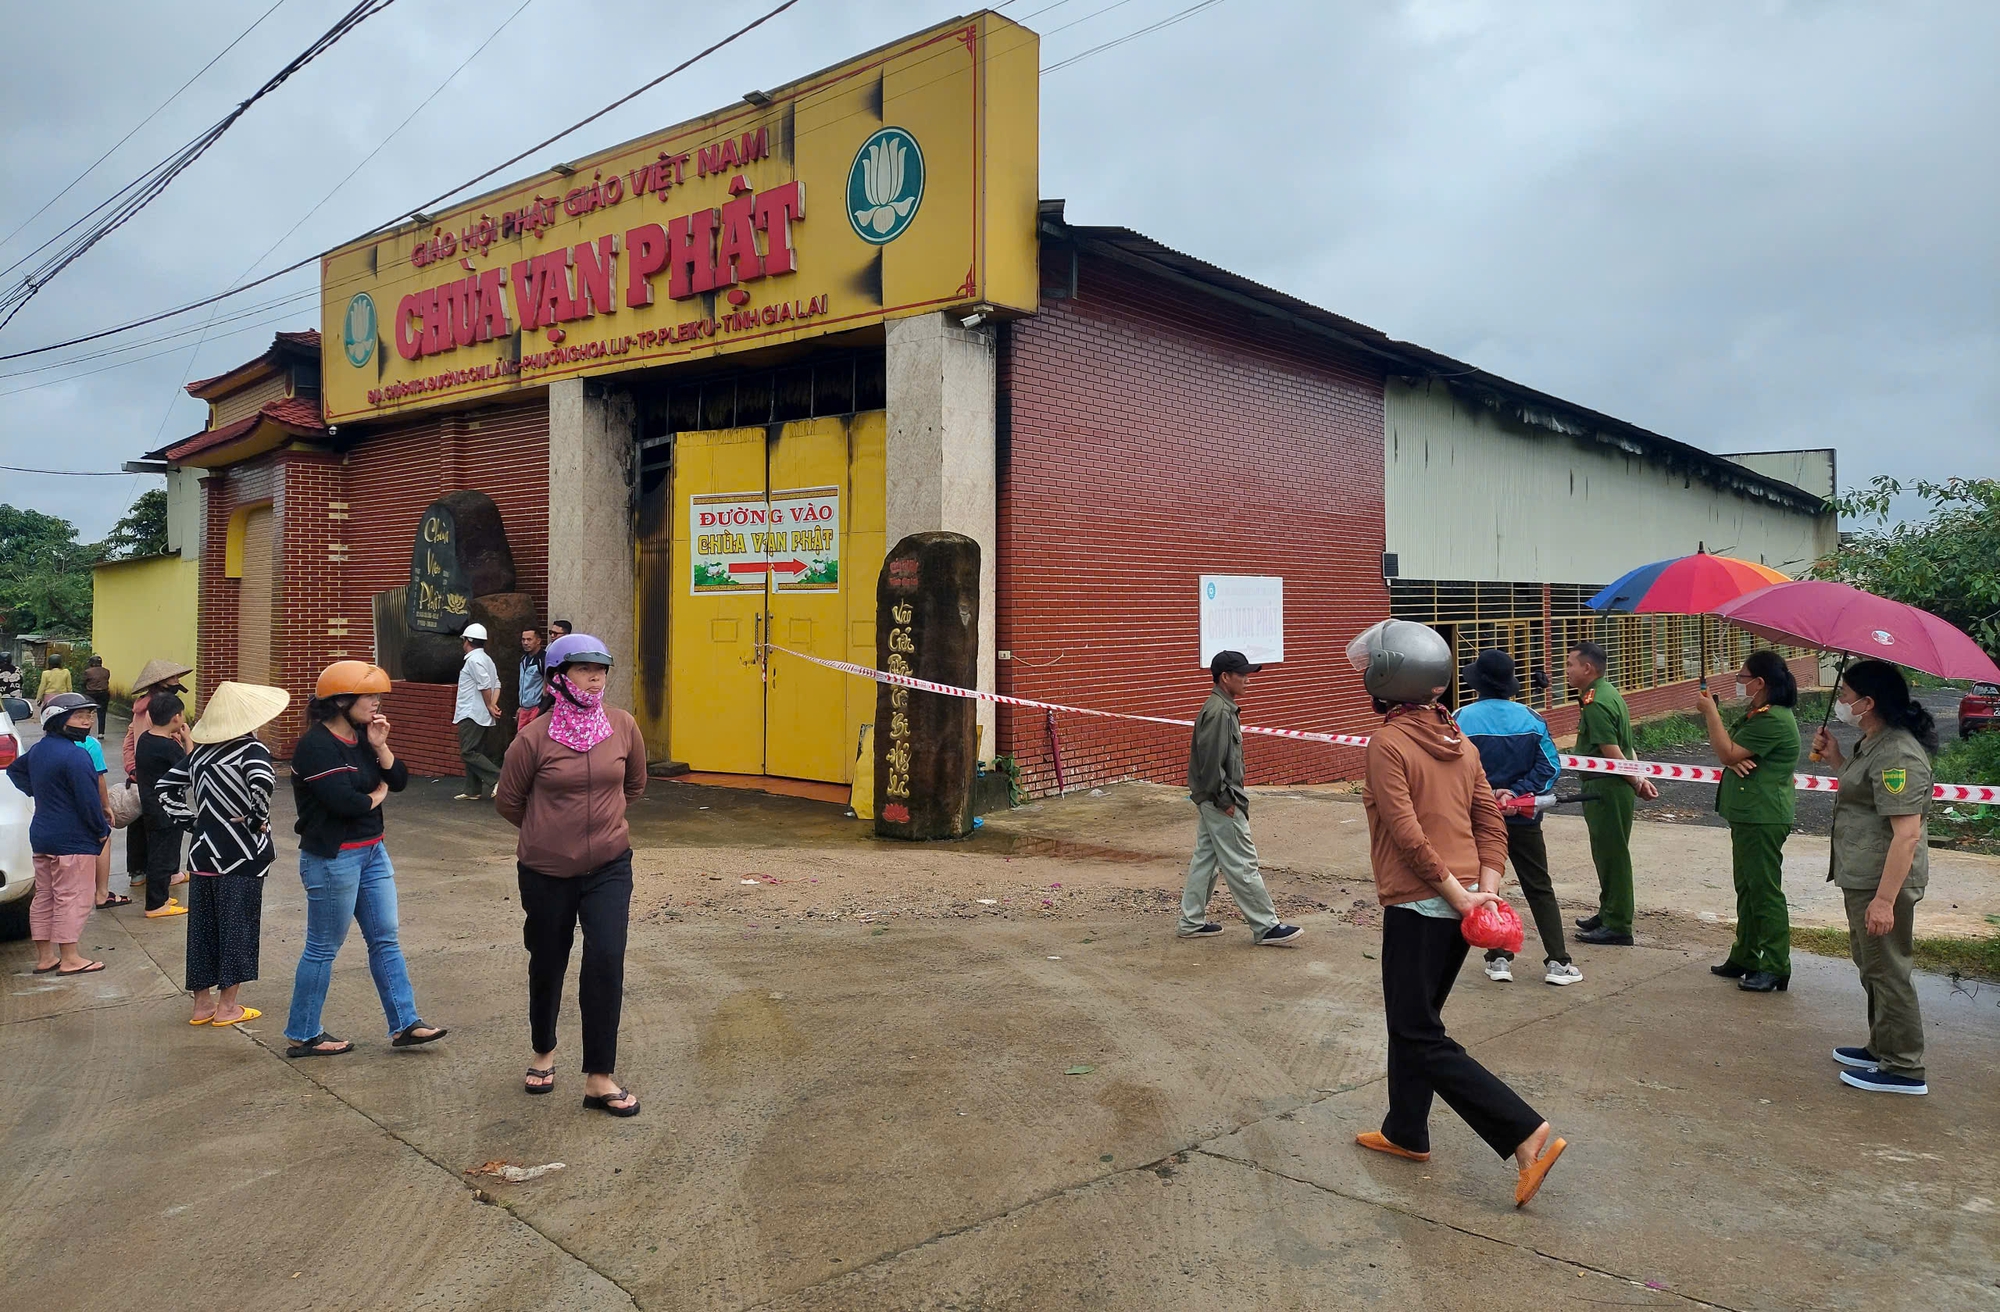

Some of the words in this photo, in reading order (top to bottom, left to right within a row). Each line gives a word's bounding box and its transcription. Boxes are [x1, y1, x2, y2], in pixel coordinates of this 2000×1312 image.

[411, 227, 457, 267] GIÁO
[461, 213, 499, 257] HỘI
[502, 194, 560, 239] PHẬT
[564, 168, 624, 217] GIÁO
[629, 151, 690, 203] VIỆT
[697, 126, 770, 178] NAM
[395, 258, 513, 363] CHÙA
[511, 234, 620, 346] VẠN
[625, 174, 806, 307] PHẬT
[761, 302, 795, 325] GIA
[796, 293, 828, 318] LAI
[699, 507, 785, 527] ĐƯỜNG
[790, 502, 833, 522] VÀO
[698, 529, 747, 555] CHÙA
[751, 531, 787, 557] VẠN
[791, 525, 834, 555] PHẬT
